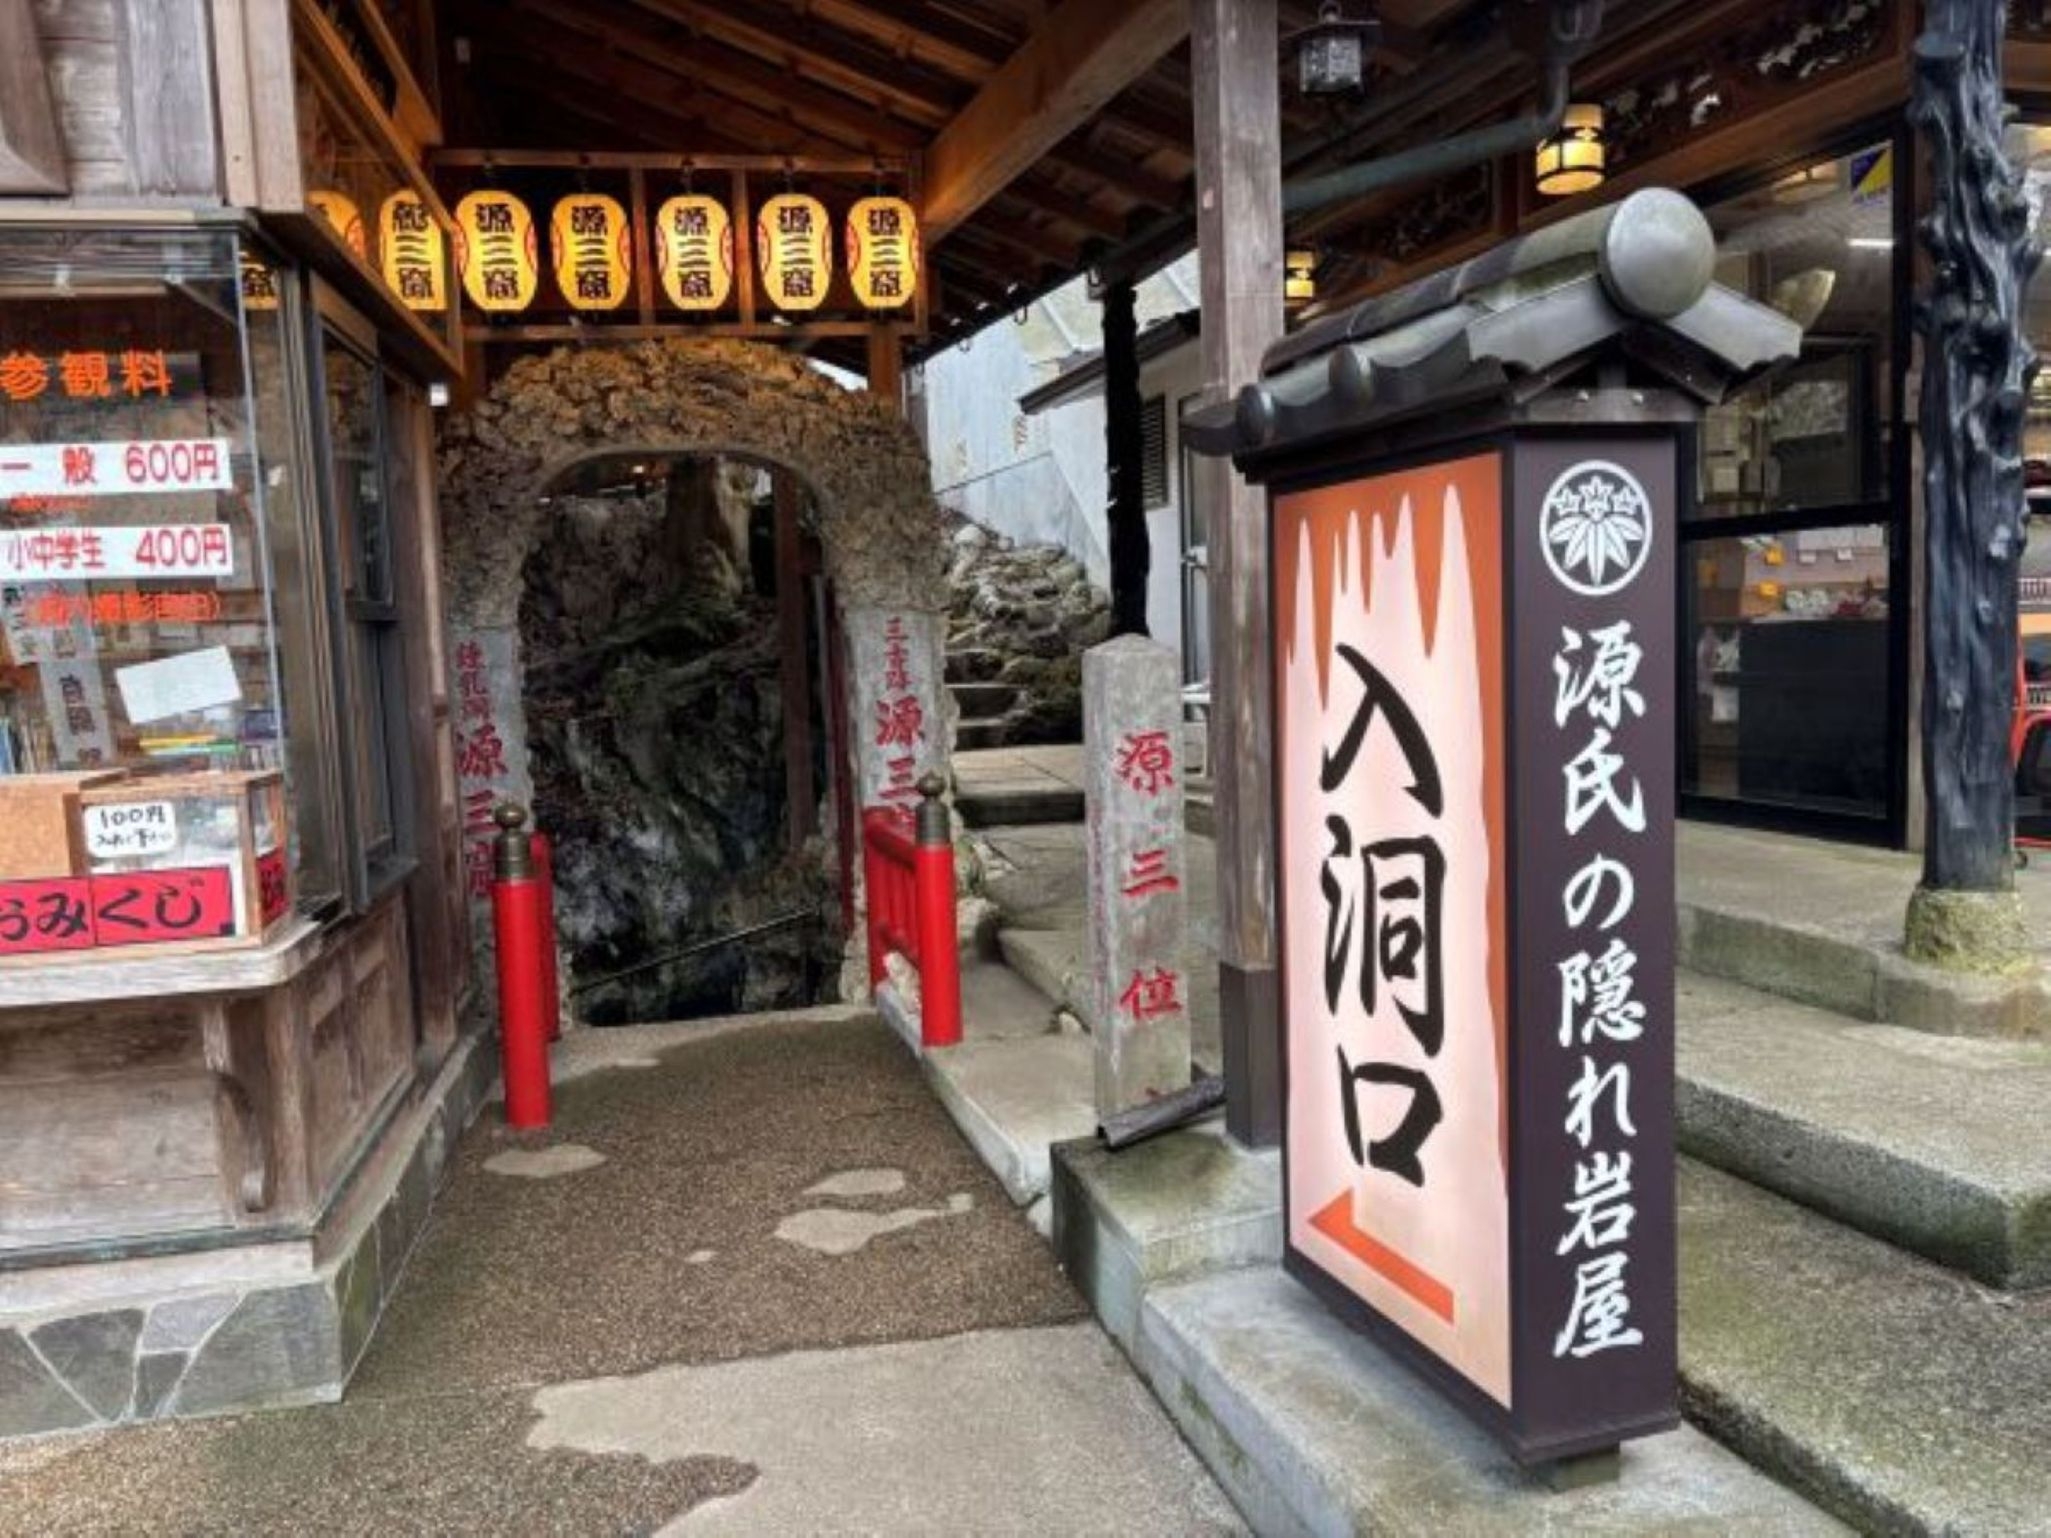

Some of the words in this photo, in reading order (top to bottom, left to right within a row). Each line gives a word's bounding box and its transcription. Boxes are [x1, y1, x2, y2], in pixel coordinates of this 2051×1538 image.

[0, 351, 172, 399] 参観料
[1, 446, 97, 484] 一般
[126, 442, 219, 483] 600円
[8, 530, 105, 570] 小中学生
[135, 526, 229, 567] 400円
[876, 695, 925, 822] 源三
[1116, 731, 1182, 1022] 源三位
[1320, 643, 1447, 1187] 入洞口
[1553, 619, 1647, 1358] 源氏の隠れ岩屋
